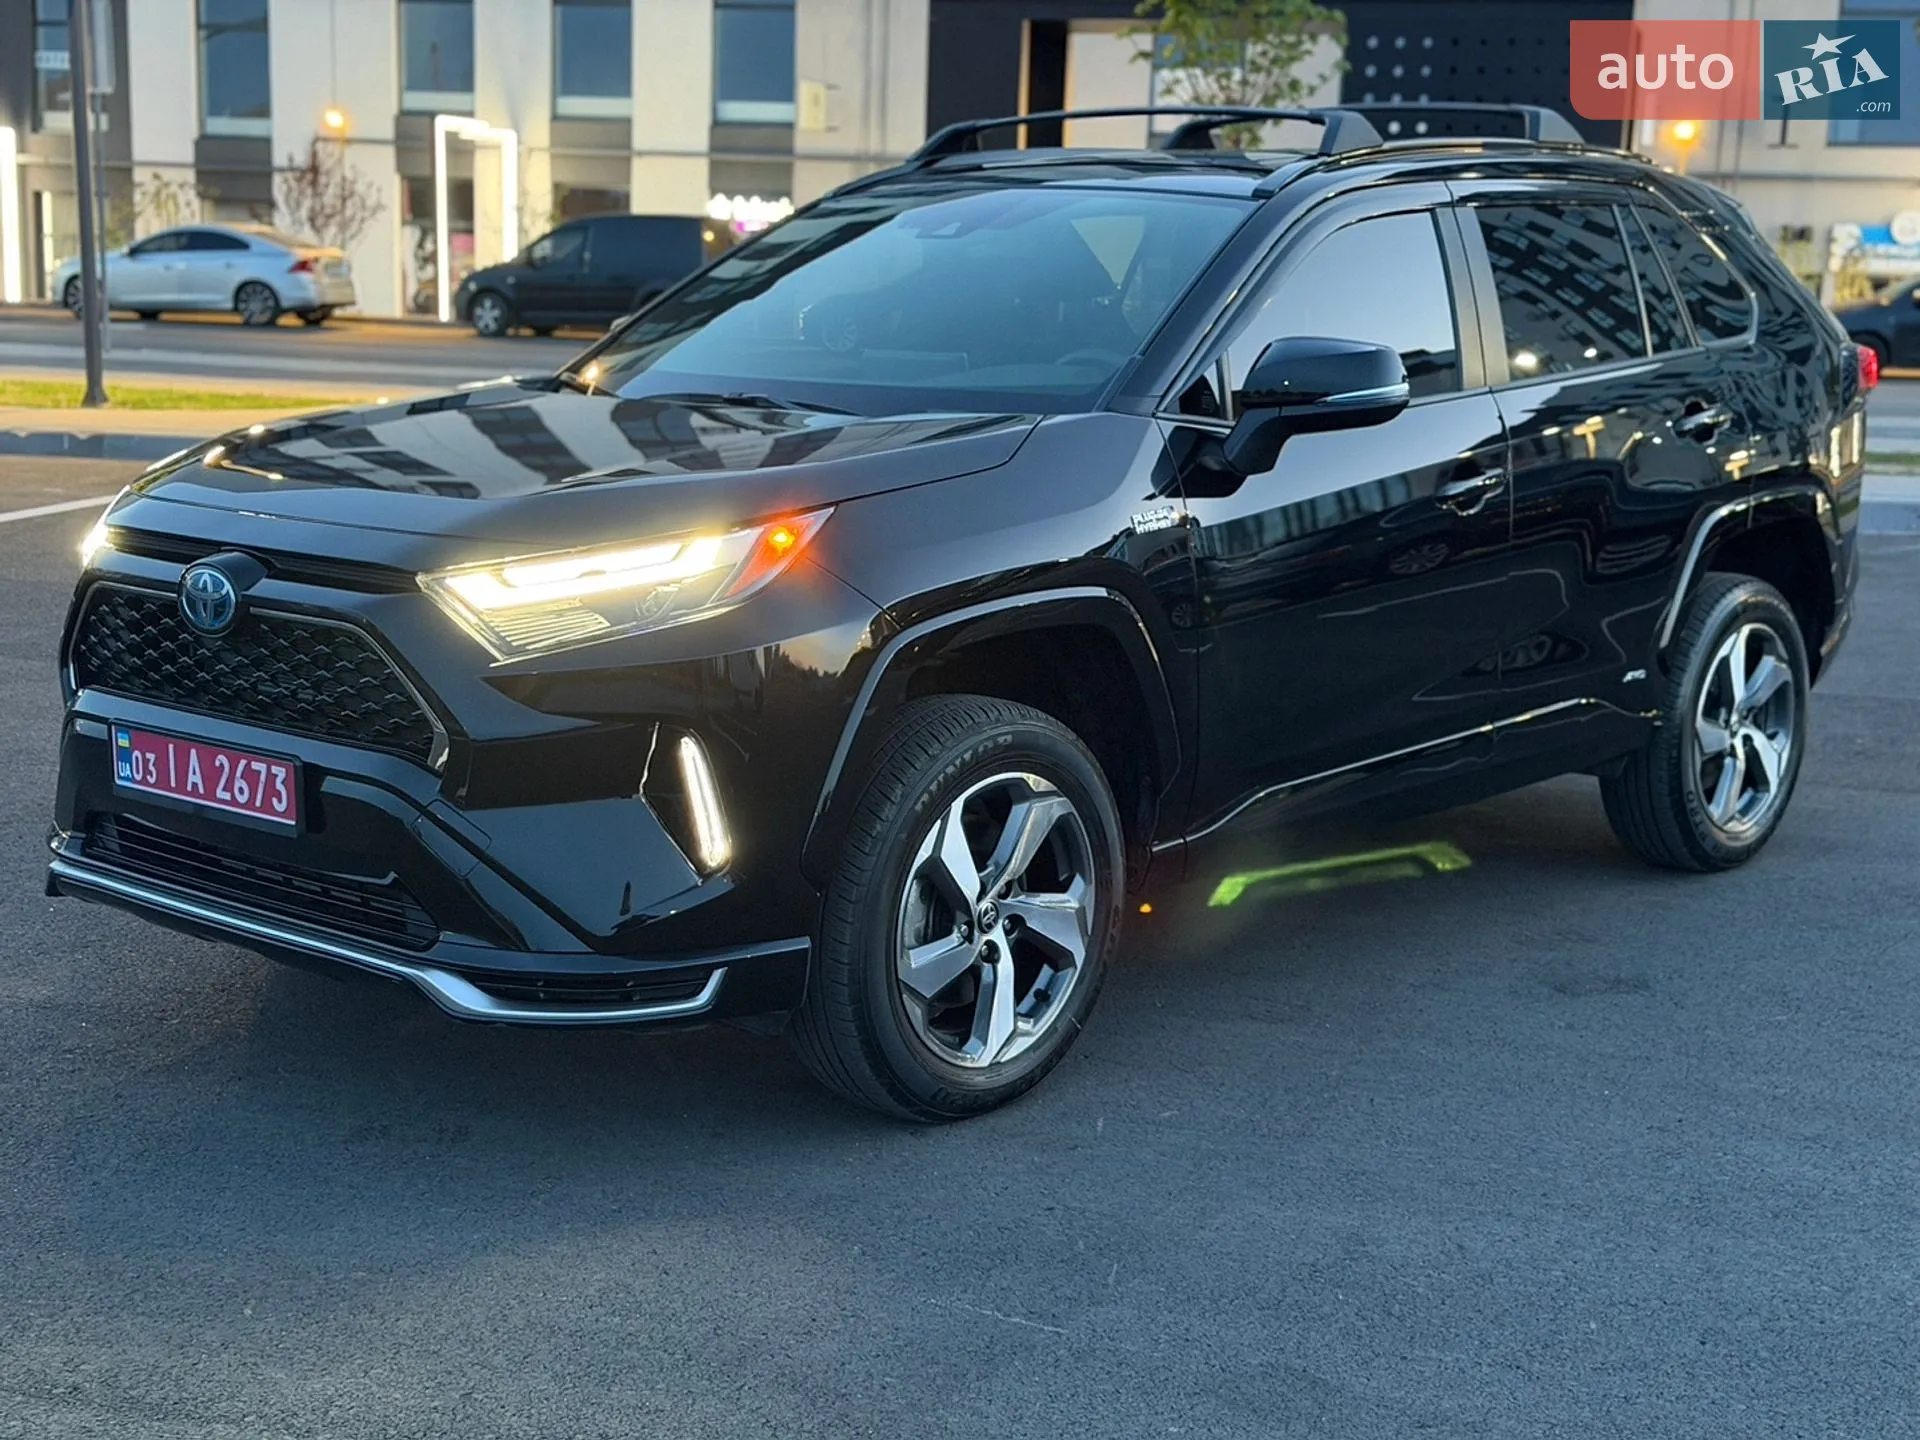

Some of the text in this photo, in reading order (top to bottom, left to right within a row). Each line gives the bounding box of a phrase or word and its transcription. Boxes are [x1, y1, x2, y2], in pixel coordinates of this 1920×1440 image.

[118, 760, 132, 778] UA
[131, 743, 288, 813] 03 IA 2673
